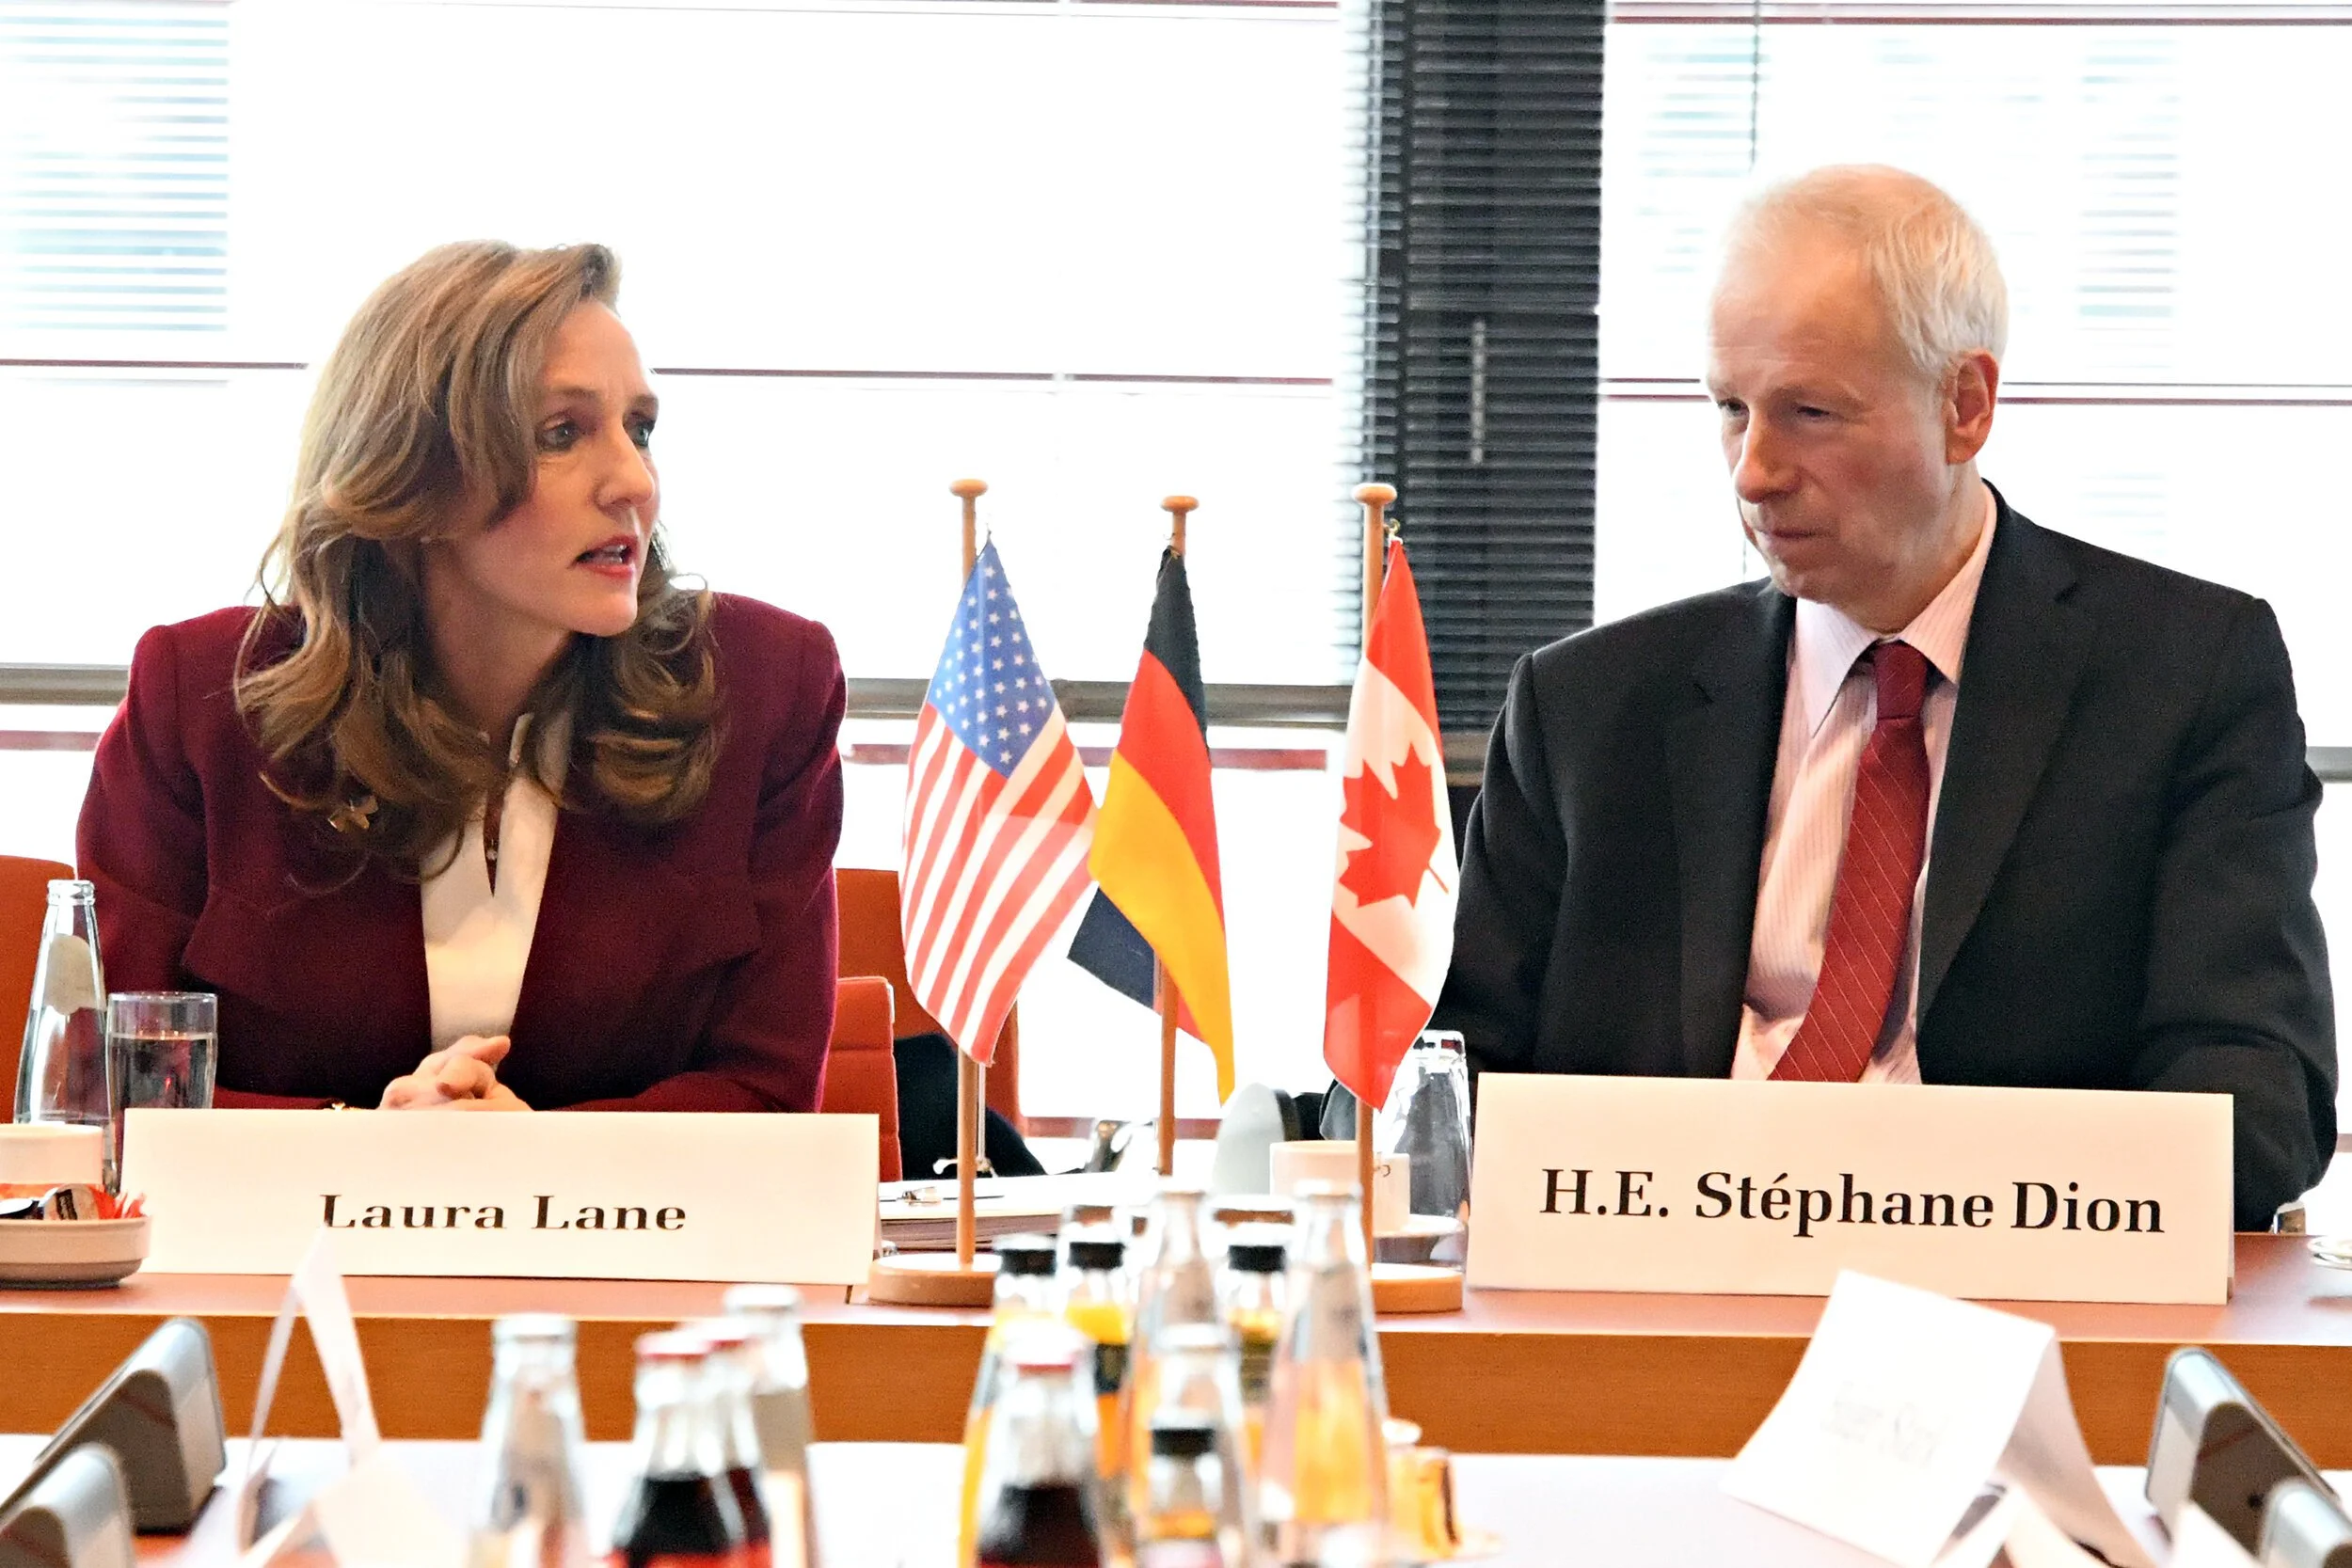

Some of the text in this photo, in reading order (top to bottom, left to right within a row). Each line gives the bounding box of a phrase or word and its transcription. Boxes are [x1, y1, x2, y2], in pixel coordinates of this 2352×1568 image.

[320, 1194, 687, 1230] Laura Lane
[1539, 1168, 2165, 1238] H.E. Stéphane Dion
